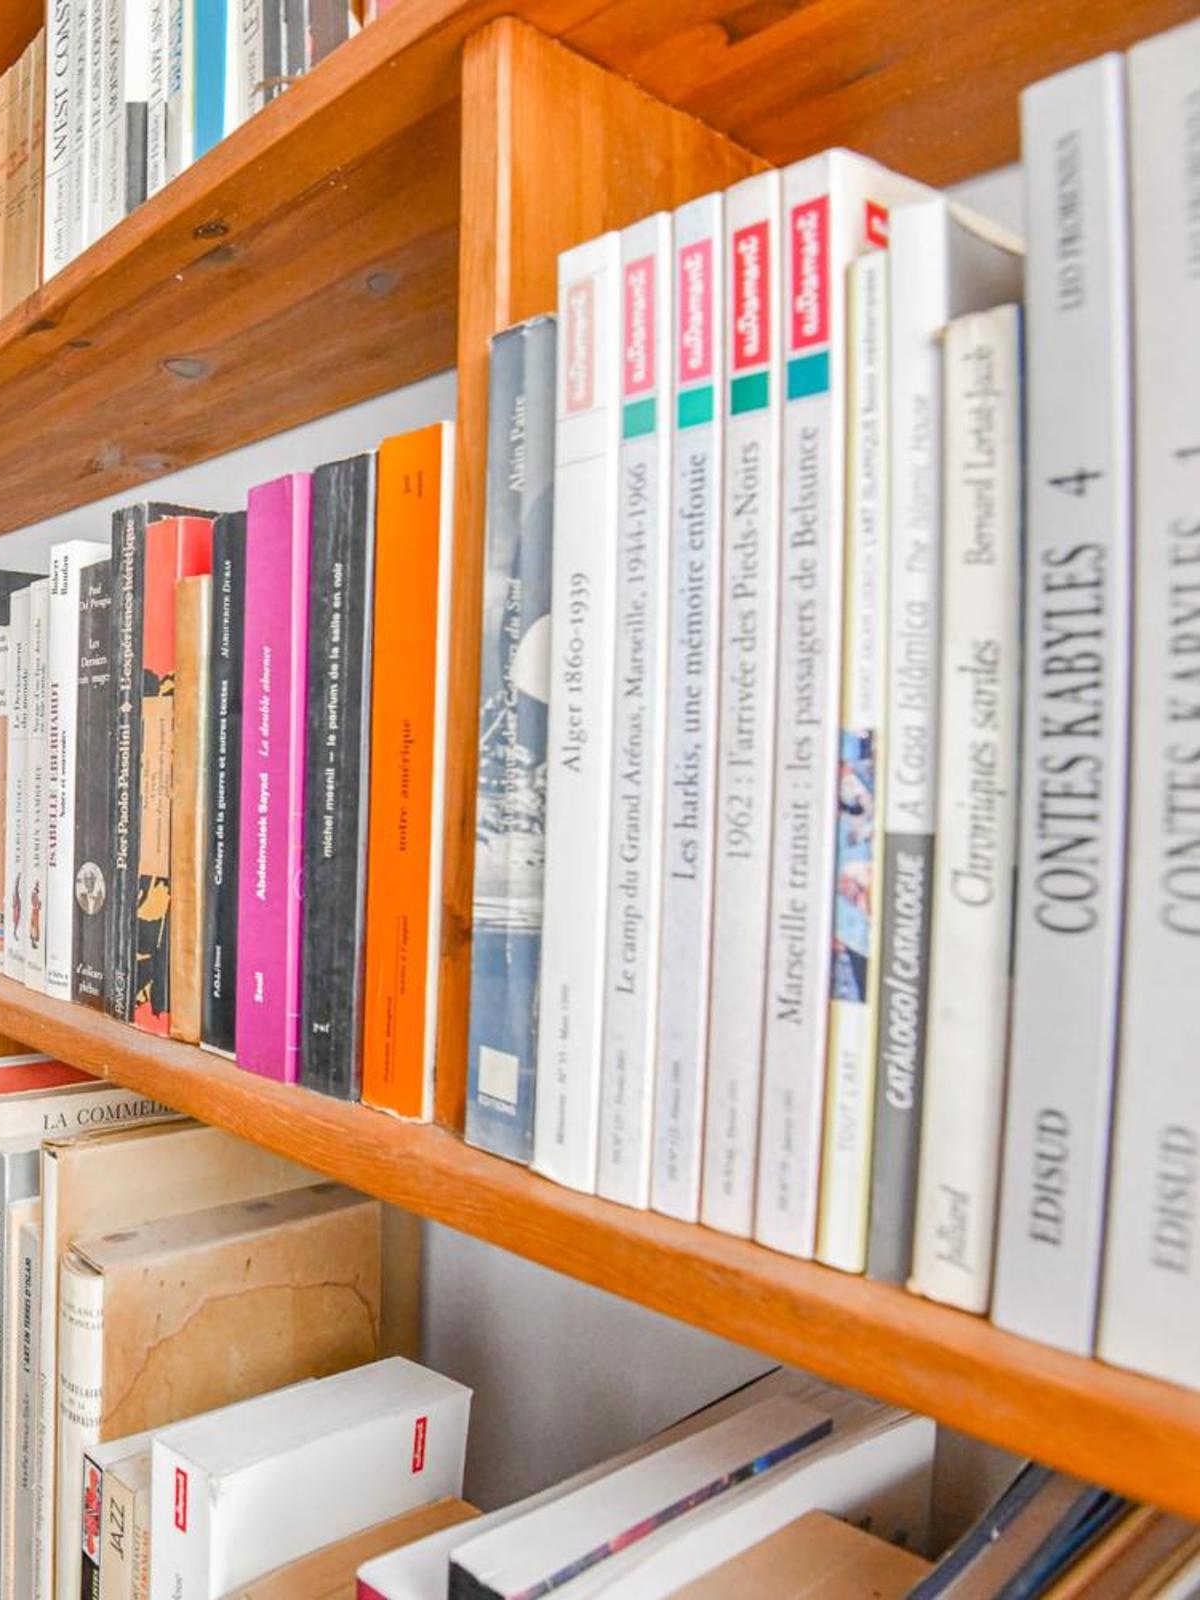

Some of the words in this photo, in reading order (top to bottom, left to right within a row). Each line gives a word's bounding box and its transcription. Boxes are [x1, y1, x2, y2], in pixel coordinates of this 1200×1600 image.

[53, 88, 68, 161] WEST
[509, 396, 527, 440] Paire
[507, 445, 526, 492] Alain
[792, 425, 819, 547] Belsunce
[1048, 467, 1103, 498] 4
[626, 462, 647, 583] 1944-1966
[682, 453, 707, 550] enfouie
[729, 440, 759, 601] Pieds-Noirs
[961, 478, 996, 565] Bernard
[333, 563, 344, 588] noir
[505, 578, 521, 612] Sud
[789, 558, 815, 590] de
[334, 592, 342, 608] en
[680, 559, 704, 675] mémoire
[119, 589, 135, 690] L'expérience
[331, 613, 341, 642] salle
[561, 571, 590, 694] 1860-1939
[624, 590, 648, 697] Marseille,
[732, 609, 757, 652] des
[1040, 542, 1106, 740] KABYLES
[260, 646, 271, 692] absence
[328, 663, 339, 679] de
[330, 646, 340, 658] la
[793, 599, 820, 725] passagers
[220, 680, 229, 715] textes
[328, 683, 341, 729] parfum
[957, 638, 1002, 730] sardes
[259, 695, 270, 736] double
[683, 686, 701, 732] une
[728, 662, 755, 767] l'arrivée
[118, 723, 131, 788] Pasolini
[219, 718, 228, 753] autres
[258, 740, 270, 756] La
[327, 735, 336, 746] le
[562, 704, 586, 773] Alger
[623, 705, 646, 785] Arénas,
[786, 736, 811, 770] les
[899, 723, 925, 786] Casa
[218, 755, 226, 768] et
[216, 771, 229, 809] guerre
[257, 773, 271, 813] Sayad
[325, 767, 335, 810] mesnil
[674, 743, 701, 828] harkis,
[48, 792, 57, 868] ISABELLE
[117, 792, 129, 835] Paolo
[215, 812, 225, 822] la
[215, 825, 224, 839] de
[323, 816, 334, 857] michel
[620, 794, 642, 863] Grand
[726, 793, 753, 860] 1962
[950, 740, 1006, 906] Chroniques
[117, 837, 127, 869] Pier
[214, 841, 225, 884] Cahiers
[256, 816, 268, 900] Abdelmalek
[672, 839, 698, 880] Les
[786, 799, 810, 889] transit
[1034, 754, 1102, 935] CONTES
[619, 870, 638, 899] du
[619, 905, 643, 964] camp
[615, 968, 636, 995] Le
[777, 898, 807, 1025] Marseille
[253, 972, 264, 1003] Seuil
[43, 1114, 68, 1130] LA
[838, 1104, 858, 1152] TOUT
[1028, 1108, 1069, 1248] EDISUD
[1148, 1125, 1198, 1275] EDISUD
[109, 1497, 125, 1560] JAZZ
